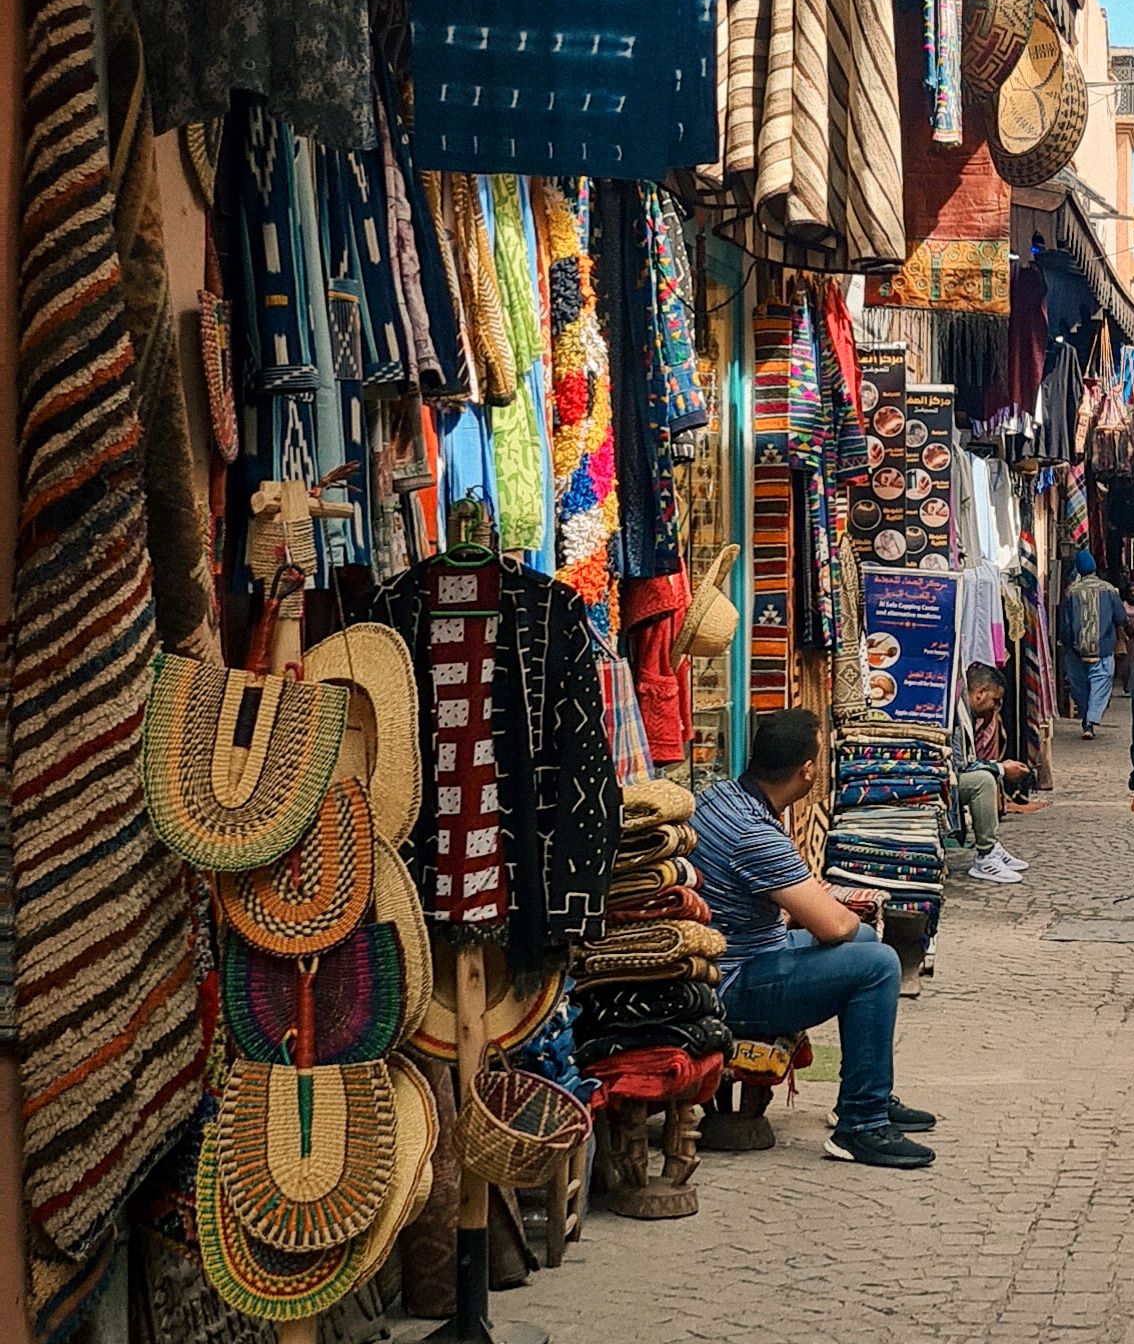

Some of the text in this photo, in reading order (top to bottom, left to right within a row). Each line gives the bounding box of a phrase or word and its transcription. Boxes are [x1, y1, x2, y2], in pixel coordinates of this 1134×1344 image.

[880, 355, 904, 364] مركز
[907, 396, 951, 406] مركز الصف
